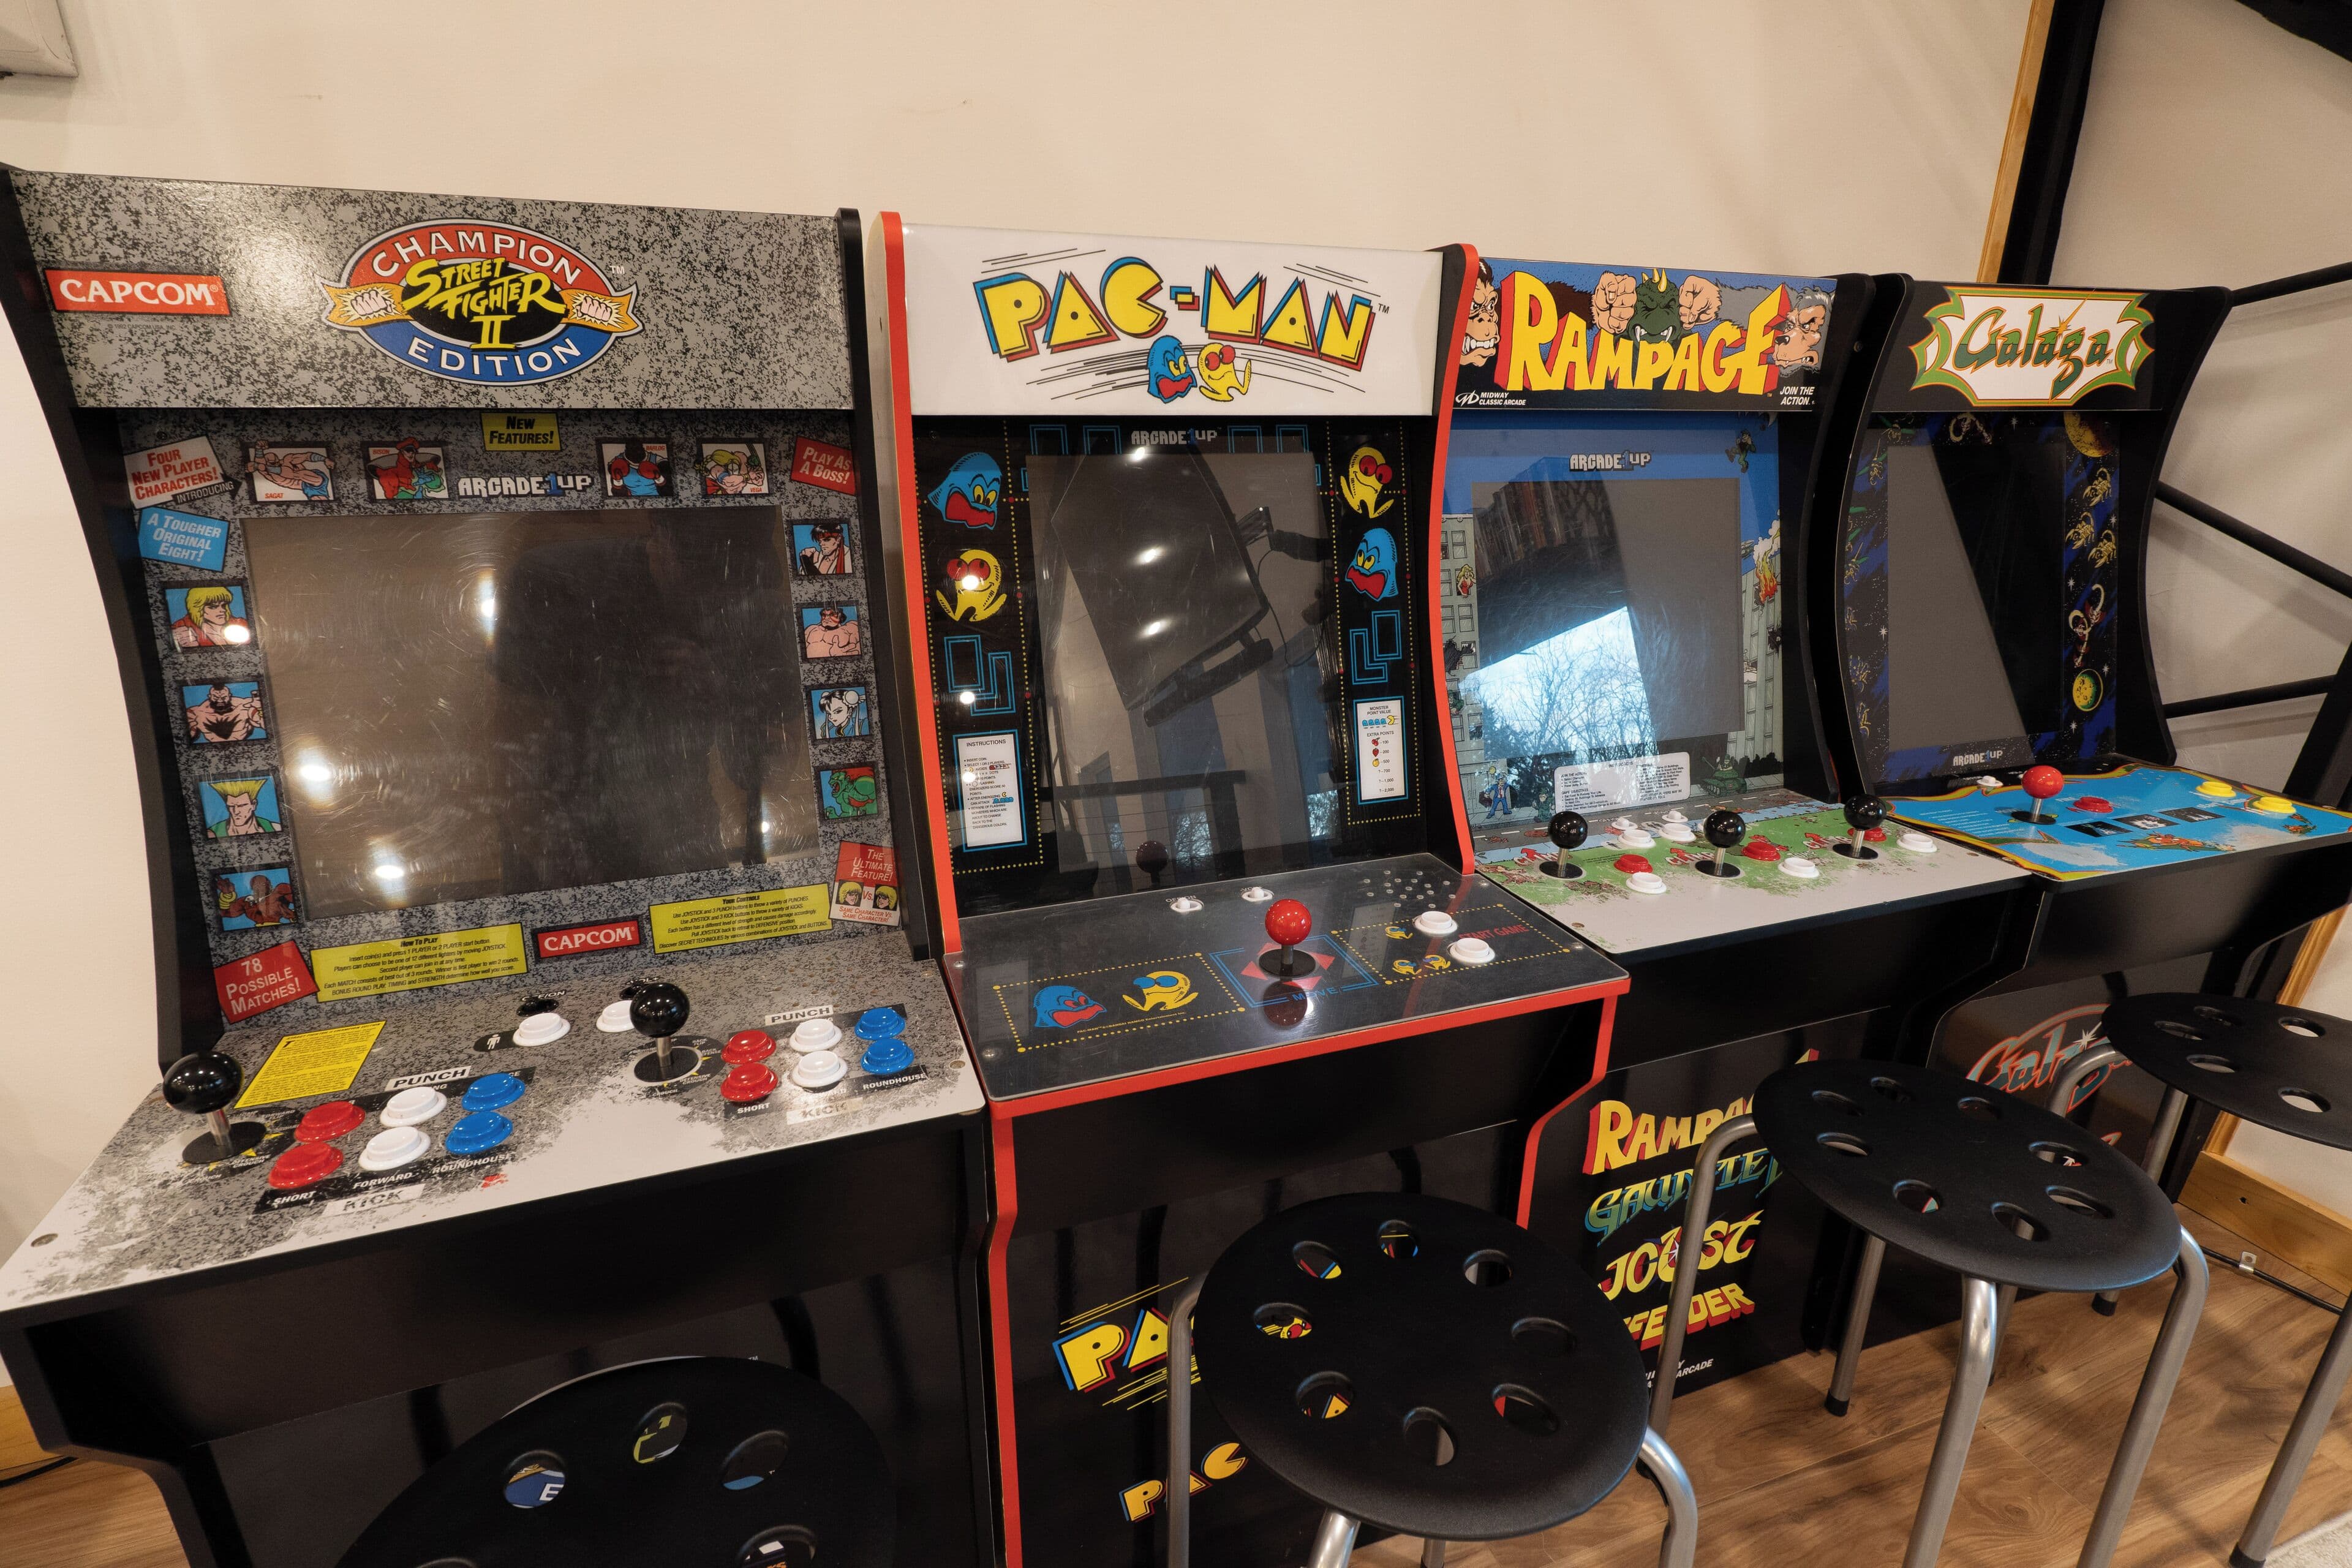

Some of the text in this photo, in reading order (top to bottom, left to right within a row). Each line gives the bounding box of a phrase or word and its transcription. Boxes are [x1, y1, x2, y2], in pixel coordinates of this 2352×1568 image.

[371, 230, 582, 286] CHAMPION
[402, 257, 508, 313] STREET
[426, 271, 567, 319] FIGHTER
[973, 256, 1376, 372] PAC-MAN
[470, 314, 520, 350] II
[1494, 271, 1792, 396] RAMPAGE
[409, 336, 582, 375] EDITION
[1953, 303, 2113, 402] Galaga
[1780, 386, 1815, 395] JOIN THE
[506, 416, 535, 430] NEW
[489, 431, 554, 445] FEATURES!
[146, 449, 181, 467] FOUR
[802, 446, 851, 470] PLAY AS
[131, 457, 209, 486] NEW PLAYER
[801, 464, 850, 484] A BOSS!
[135, 467, 218, 501] CHARACTERS!
[176, 481, 235, 504] INTRODUCING
[147, 513, 222, 538] A TOUGHER
[153, 529, 211, 551] ORIGINAL
[157, 545, 205, 562] EIGHT!
[867, 849, 884, 860] THE
[851, 867, 893, 881] FEATURE!
[853, 858, 893, 872] ULTIMATE
[854, 907, 884, 917] CHARACTER
[858, 913, 889, 922] CHARACTER!
[1493, 924, 1529, 937] GAME
[241, 957, 263, 976] 78
[225, 966, 294, 1000] POSSIBLE
[230, 978, 301, 1015] MATCHES!
[1292, 987, 1338, 1001] MOVE
[771, 1007, 831, 1023] PUNCH
[393, 1068, 467, 1088] PUNCH
[862, 1072, 927, 1090] ROUNDHOUSE
[737, 1102, 771, 1114] SHORT
[432, 1153, 513, 1175] ROUNDHOUSE
[353, 1171, 414, 1190] FORWARD
[273, 1190, 316, 1205] SHORT
[1676, 1359, 1714, 1378] ARCADE
